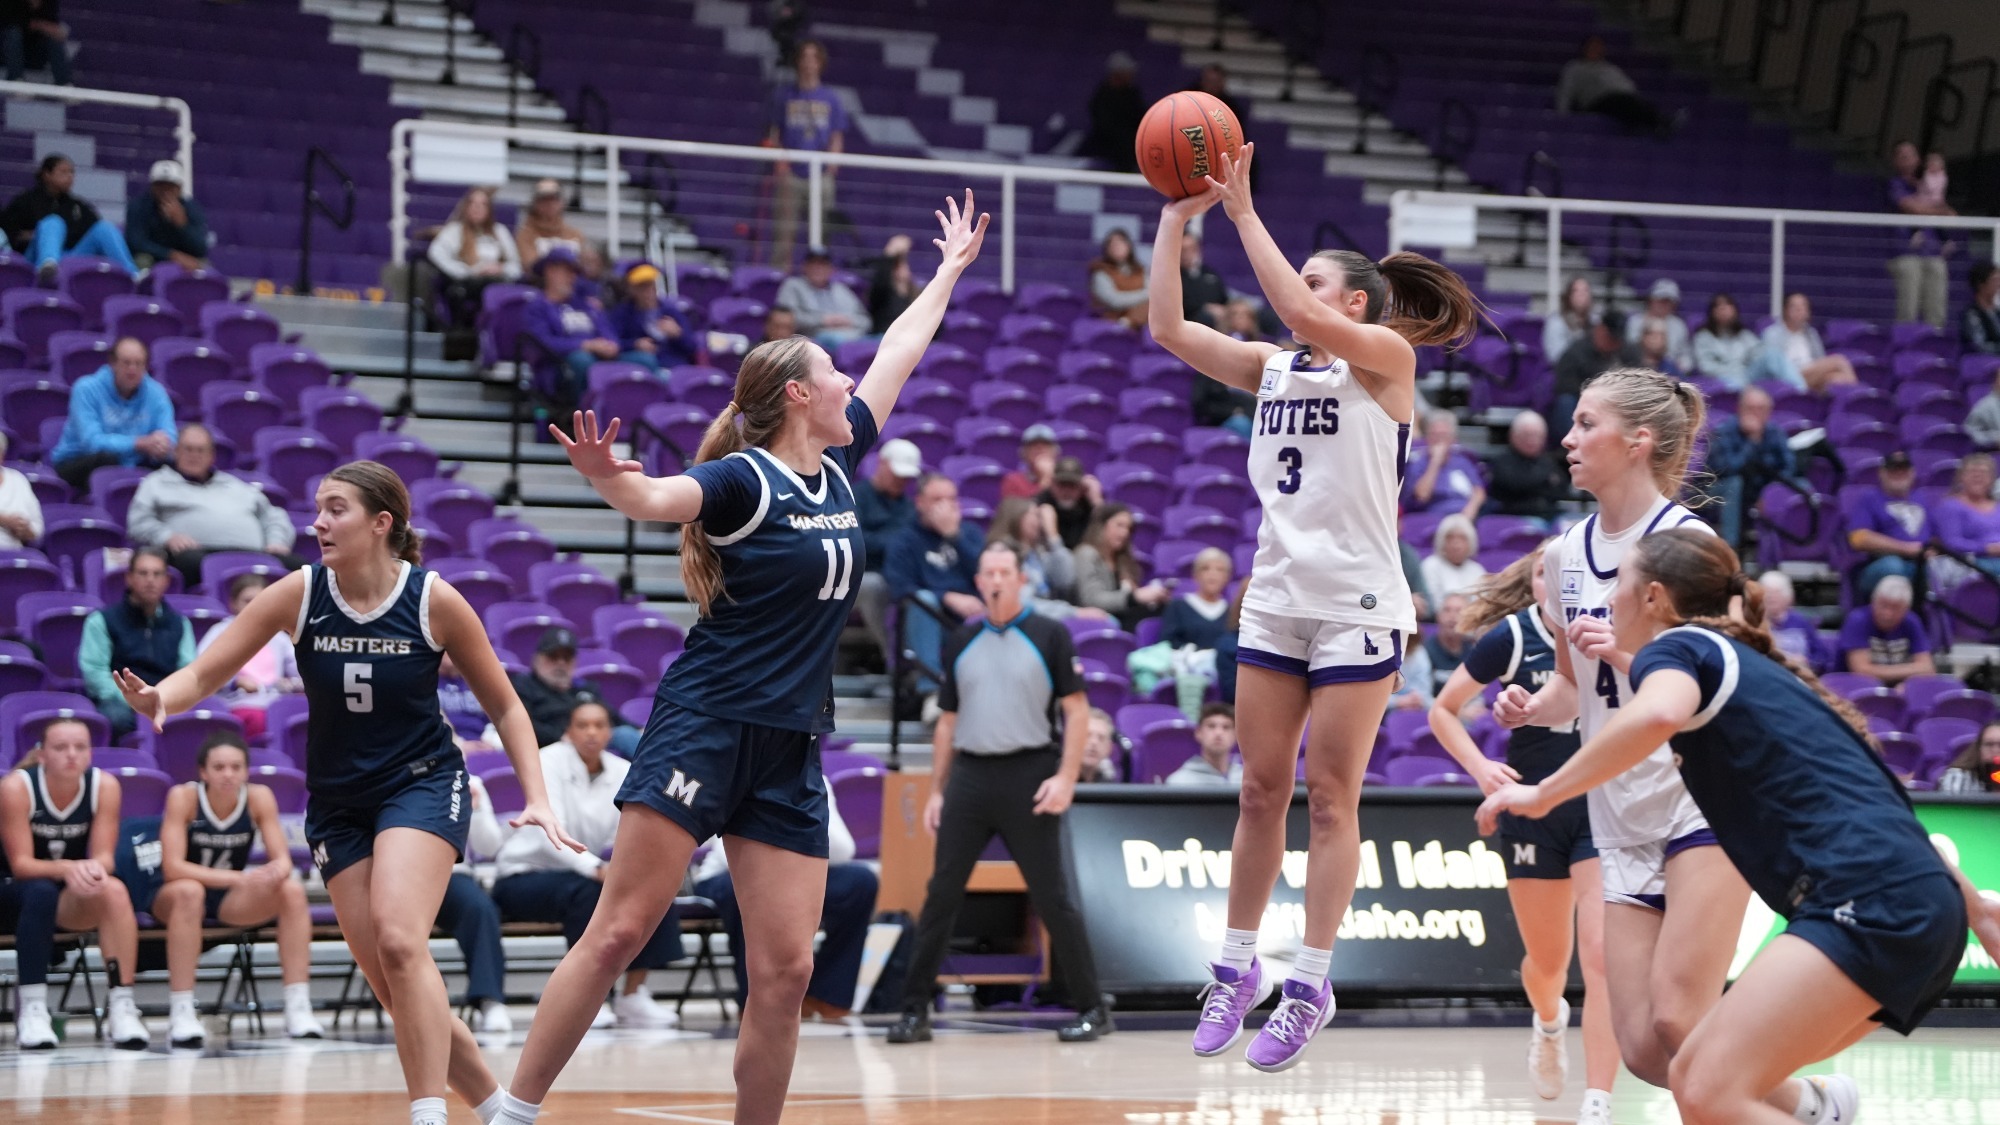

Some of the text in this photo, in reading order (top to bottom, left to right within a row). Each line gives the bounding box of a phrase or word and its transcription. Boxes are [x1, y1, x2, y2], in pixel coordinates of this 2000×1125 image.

[1180, 125, 1210, 178] NAIA
[1260, 397, 1339, 436] YOTES
[1277, 447, 1302, 495] 3
[817, 538, 853, 601] 11
[313, 636, 412, 654] MASTER'S
[343, 662, 374, 713] 5
[1596, 656, 1620, 709] 4
[662, 767, 703, 809] M
[1392, 840, 1508, 889] Idah
[1512, 842, 1537, 866] M
